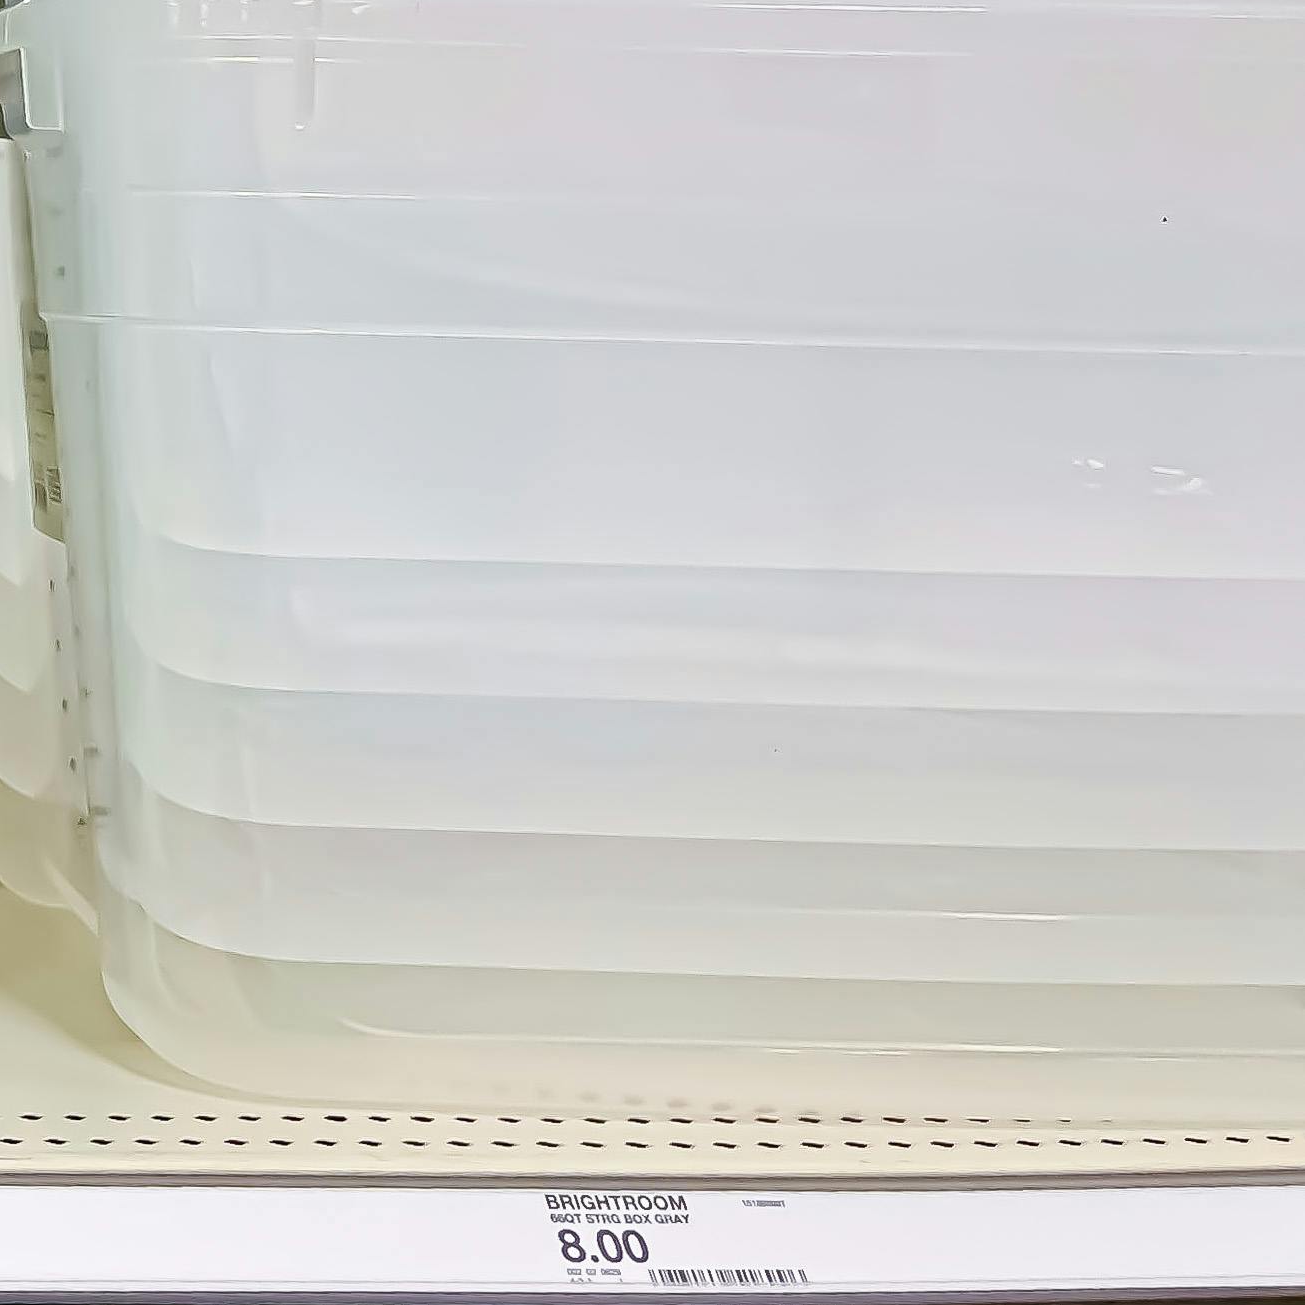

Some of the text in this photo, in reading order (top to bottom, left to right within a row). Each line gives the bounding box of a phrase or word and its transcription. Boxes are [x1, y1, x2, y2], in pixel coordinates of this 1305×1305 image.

[544, 1194, 688, 1211] BRIGHTROOM
[585, 1213, 622, 1224] STRG
[623, 1213, 652, 1224] BOX
[654, 1213, 690, 1225] GRAY
[557, 1228, 650, 1263] 8.00
